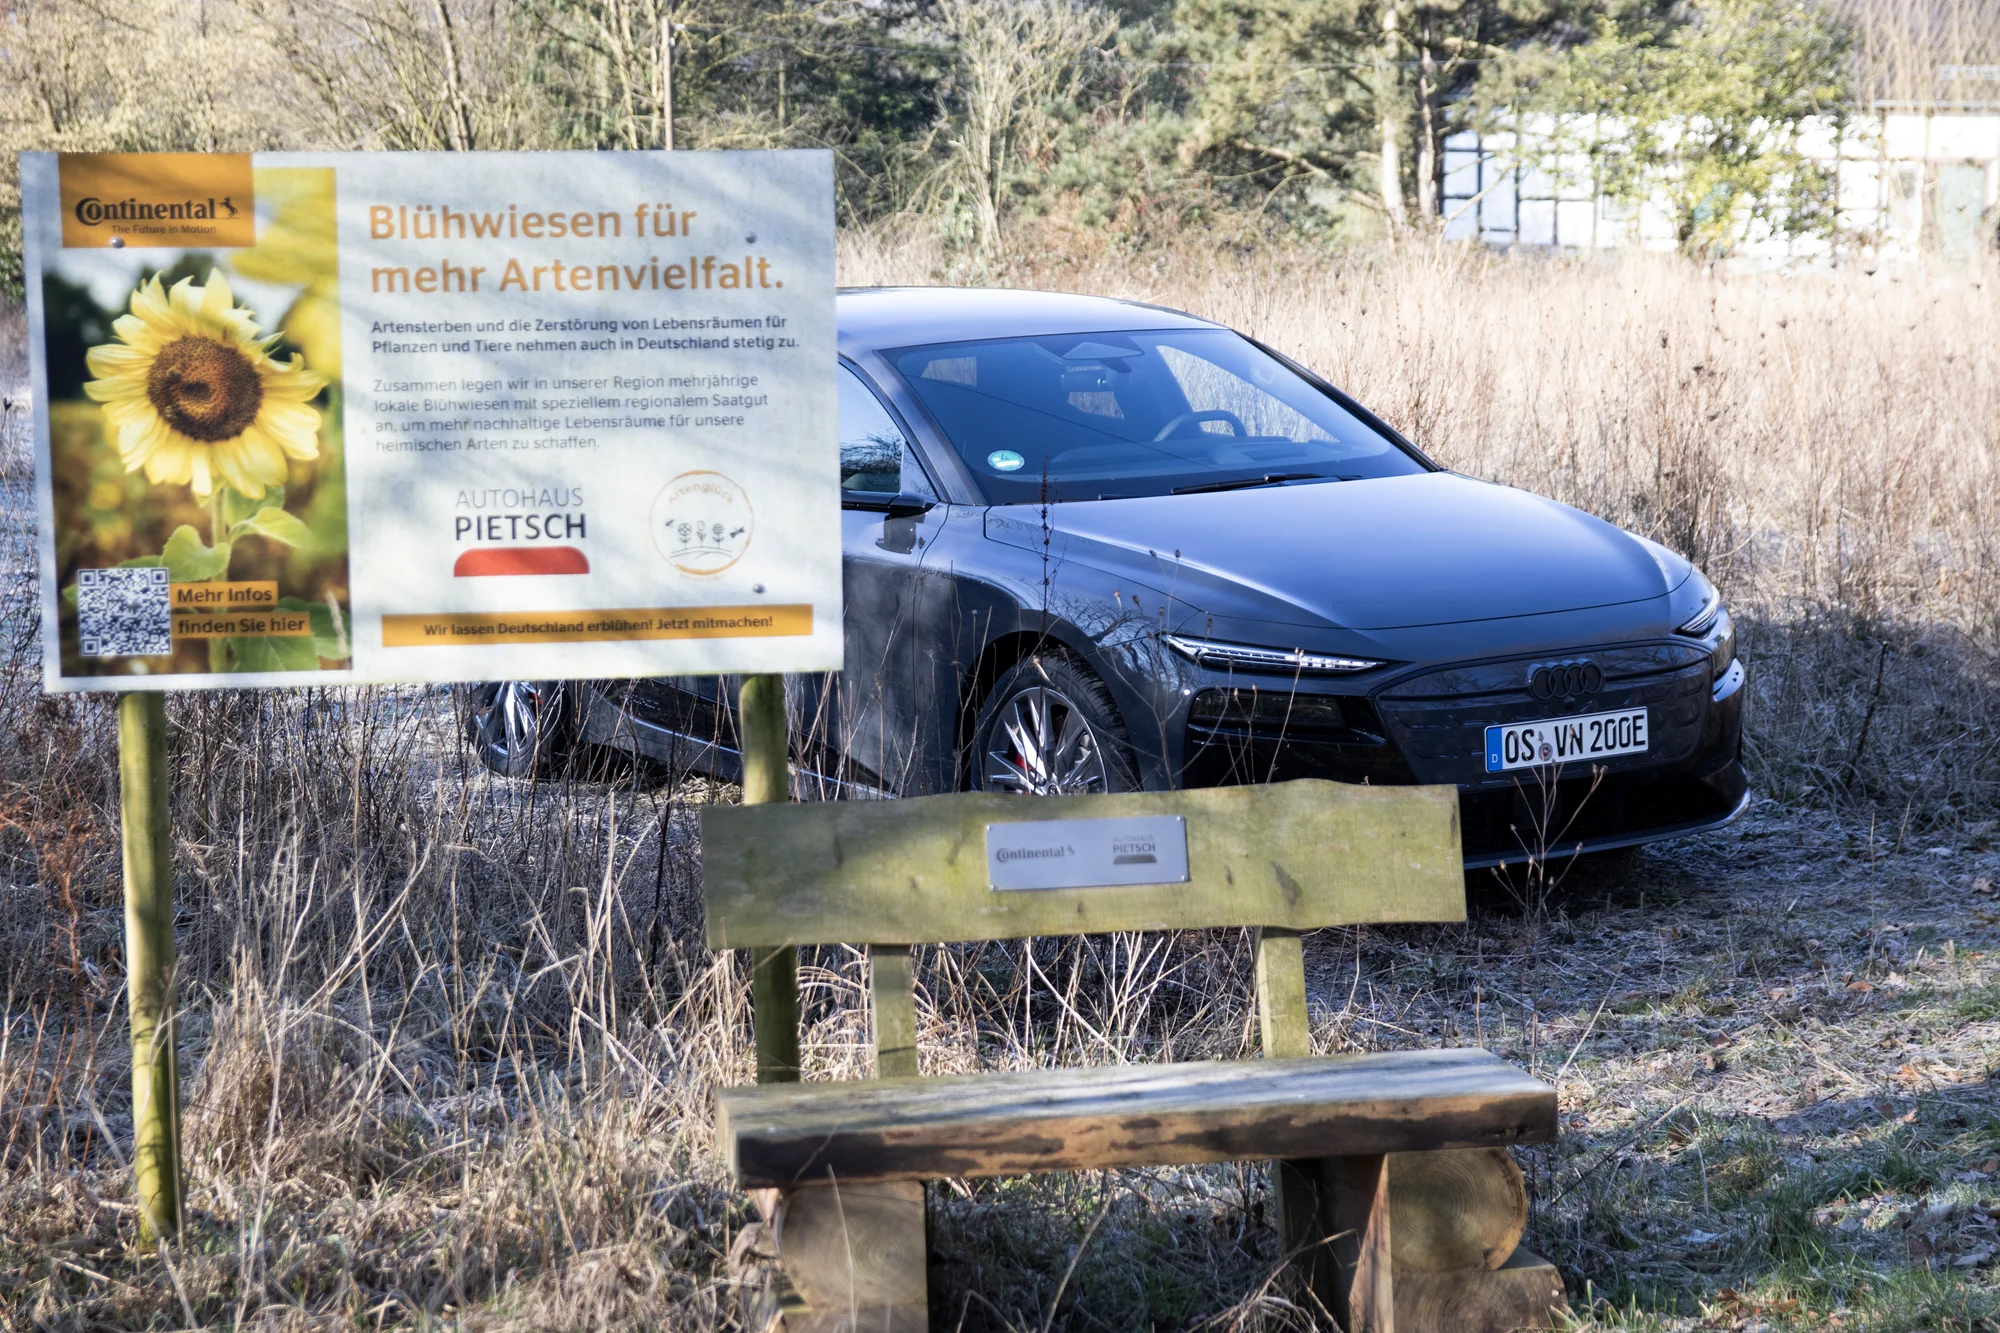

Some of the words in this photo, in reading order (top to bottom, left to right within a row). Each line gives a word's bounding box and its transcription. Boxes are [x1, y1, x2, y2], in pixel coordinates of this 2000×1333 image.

[75, 196, 216, 226] Continental
[112, 225, 128, 235] The
[133, 224, 165, 235] Future
[168, 224, 178, 235] in
[181, 225, 216, 235] Motion
[369, 204, 622, 240] Blühwiesen
[635, 202, 697, 236] für
[371, 257, 486, 293] mehr
[501, 255, 785, 291] Artenvielfalt.
[371, 320, 472, 333] Artensterben
[476, 319, 505, 332] und
[509, 319, 531, 332] die
[535, 318, 618, 333] Zerstörung
[622, 319, 649, 330] von
[653, 317, 763, 330] Lebensräumen
[766, 316, 787, 329] für
[372, 340, 440, 354] Pflanzen
[442, 340, 470, 353] und
[474, 339, 512, 352] Tiere
[516, 339, 576, 351] nehmen
[580, 338, 616, 351] auch
[621, 338, 634, 350] in
[638, 337, 729, 350] Deutschland
[733, 336, 774, 350] stetig
[778, 337, 800, 348] zu.
[373, 378, 457, 392] Zusammen
[462, 378, 502, 393] legen
[508, 377, 529, 390] wir
[535, 377, 547, 389] in
[552, 378, 608, 390] unserer
[614, 376, 664, 390] Region
[668, 374, 758, 389] mehrjährige
[375, 399, 419, 412] lokale
[424, 398, 510, 411] Blühwiesen
[514, 398, 537, 410] mit
[542, 396, 621, 412] speziellem
[625, 394, 708, 410] regionalem
[712, 393, 768, 408] Saatgut
[375, 420, 397, 433] an,
[401, 420, 425, 431] um
[430, 418, 470, 431] mehr
[473, 417, 561, 431] nachhaltige
[565, 414, 666, 429] Lebensräume
[670, 414, 691, 426] für
[695, 415, 745, 426] unsere
[376, 438, 462, 452] heimischen
[467, 437, 508, 450] Arten
[512, 439, 529, 450] zu
[534, 436, 600, 450] schaffen.
[456, 487, 584, 509] AUTOHAUS
[668, 483, 734, 504] Artenglück
[455, 513, 587, 541] PIETSCH
[177, 589, 224, 603] Mehr
[228, 587, 273, 602] Infos
[178, 618, 235, 634] finden
[240, 617, 266, 632] Sie
[270, 616, 306, 631] hier
[424, 622, 447, 637] Wir
[451, 621, 495, 635] lassen
[498, 621, 584, 635] Deutschland
[587, 619, 654, 633] erblühen!
[656, 617, 690, 632] Jetzt
[692, 616, 774, 631] mitmachen!
[1504, 729, 1535, 763] OS
[1555, 722, 1583, 756] VN
[1590, 714, 1646, 752] 200E
[1491, 753, 1499, 763] D
[1113, 835, 1155, 843] AUTOHAUS
[1113, 842, 1156, 854] PIETSCH
[996, 847, 1064, 863] Continental
